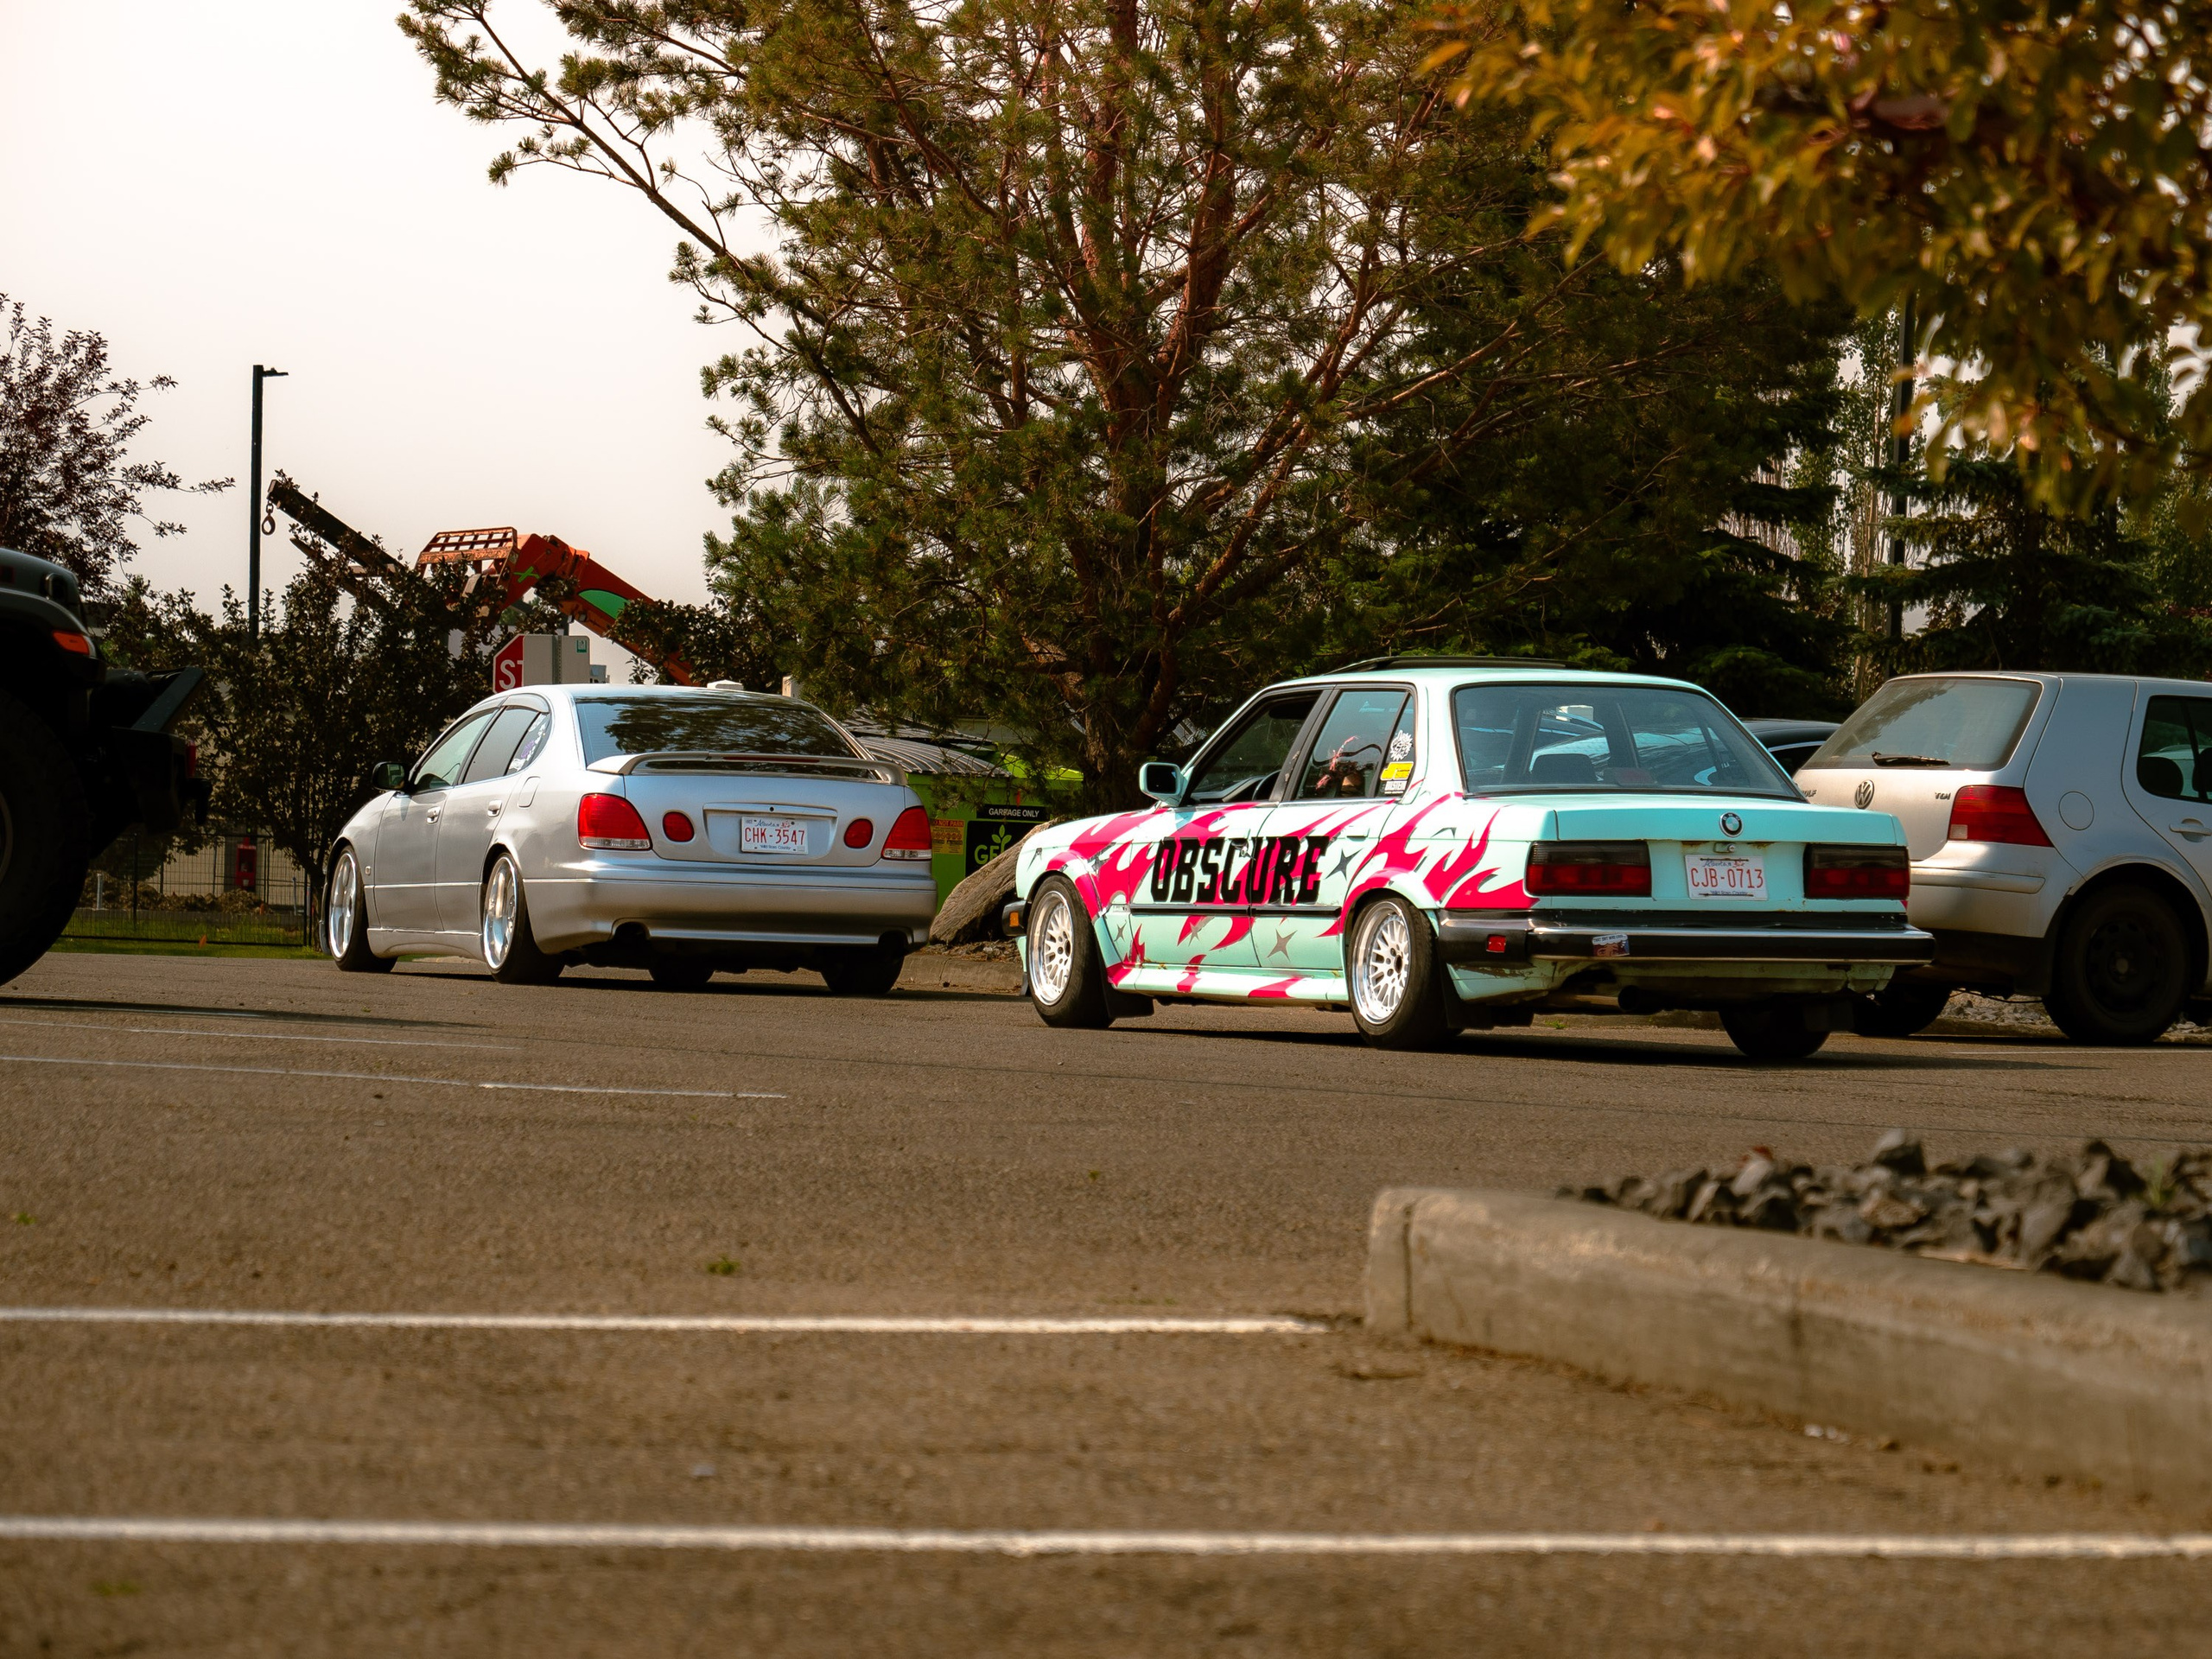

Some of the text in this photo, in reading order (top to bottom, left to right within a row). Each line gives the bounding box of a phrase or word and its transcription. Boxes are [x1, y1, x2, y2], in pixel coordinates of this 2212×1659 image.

[1022, 809, 1039, 817] ONLY
[744, 827, 805, 846] CHK-3547
[1150, 836, 1330, 904] OBSCURE
[1690, 868, 1764, 889] CJB-0713
